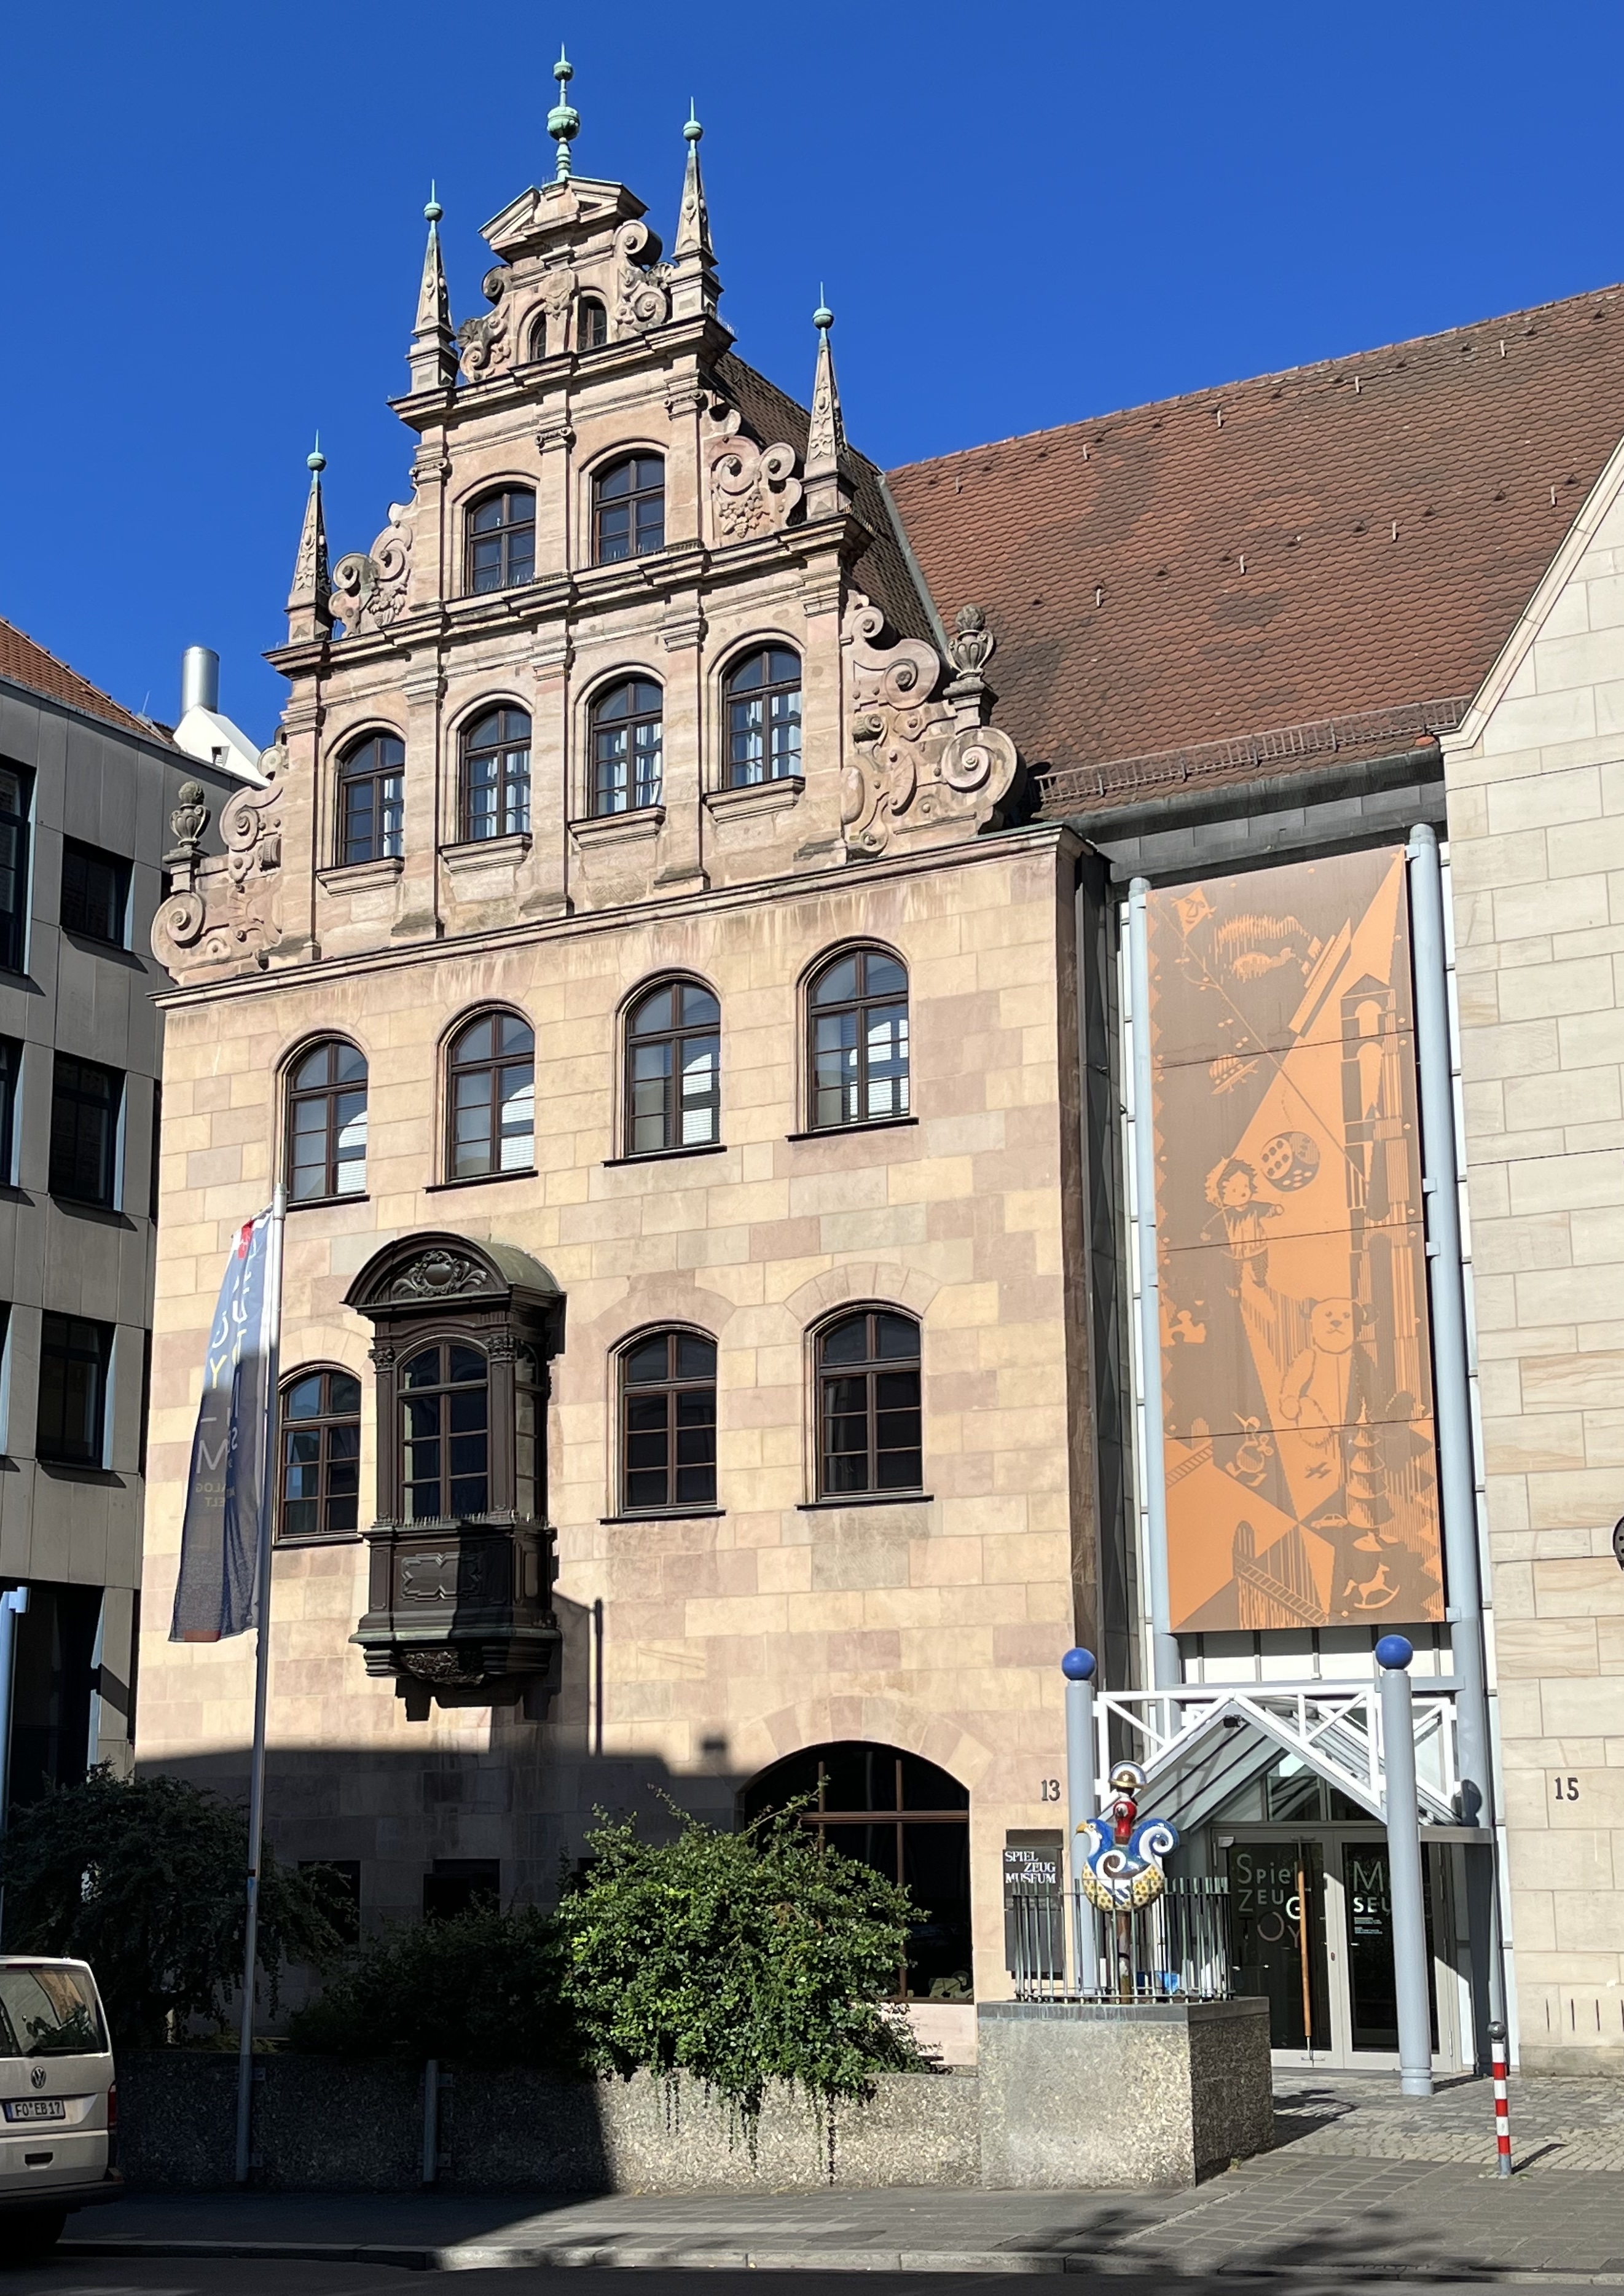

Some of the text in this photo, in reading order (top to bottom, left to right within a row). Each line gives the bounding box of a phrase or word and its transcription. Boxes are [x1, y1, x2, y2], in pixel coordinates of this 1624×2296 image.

[1041, 1779, 1060, 1801] 13
[1554, 1777, 1579, 1801] 15
[1005, 1851, 1038, 1862] SPIEL
[1024, 1862, 1056, 1873] ZEUG
